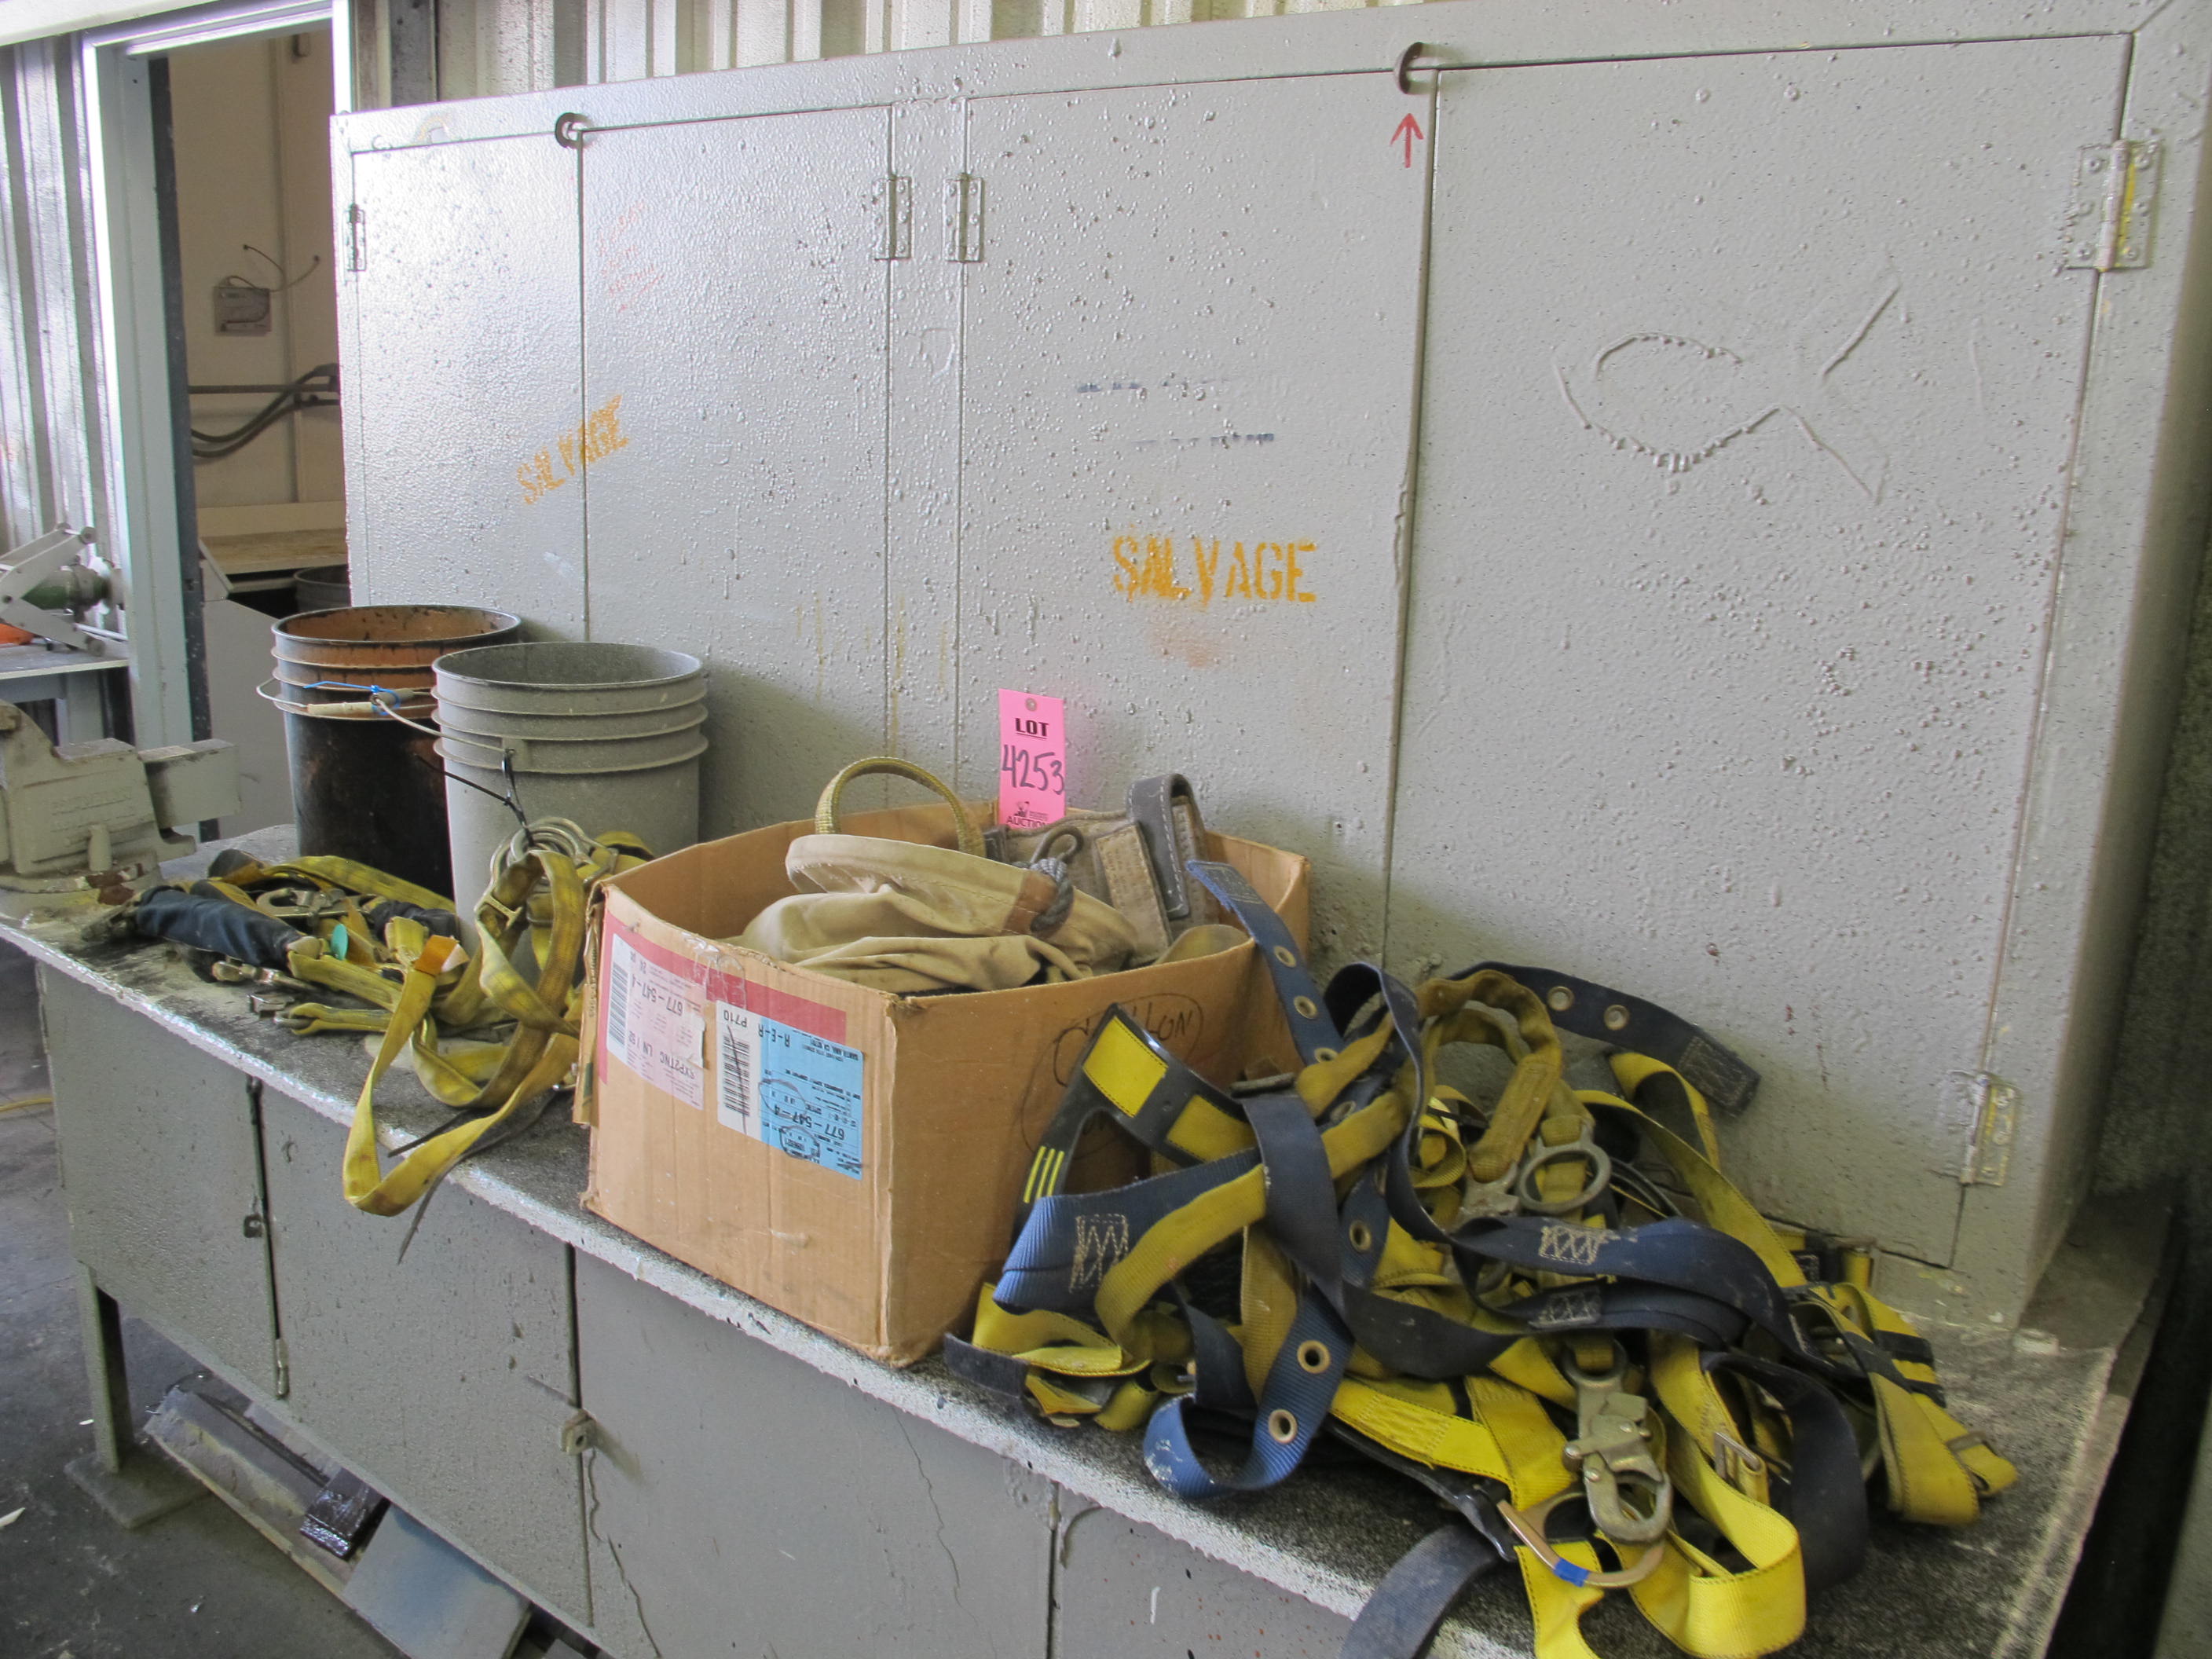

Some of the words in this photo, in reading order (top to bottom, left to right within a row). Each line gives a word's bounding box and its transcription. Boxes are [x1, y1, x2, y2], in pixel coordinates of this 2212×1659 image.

[1112, 535, 1317, 606] SALVAGE
[1015, 718, 1049, 737] LOT
[1002, 744, 1065, 795] 4253
[723, 1009, 748, 1028] P710
[775, 1104, 845, 1141] 677-547-4
